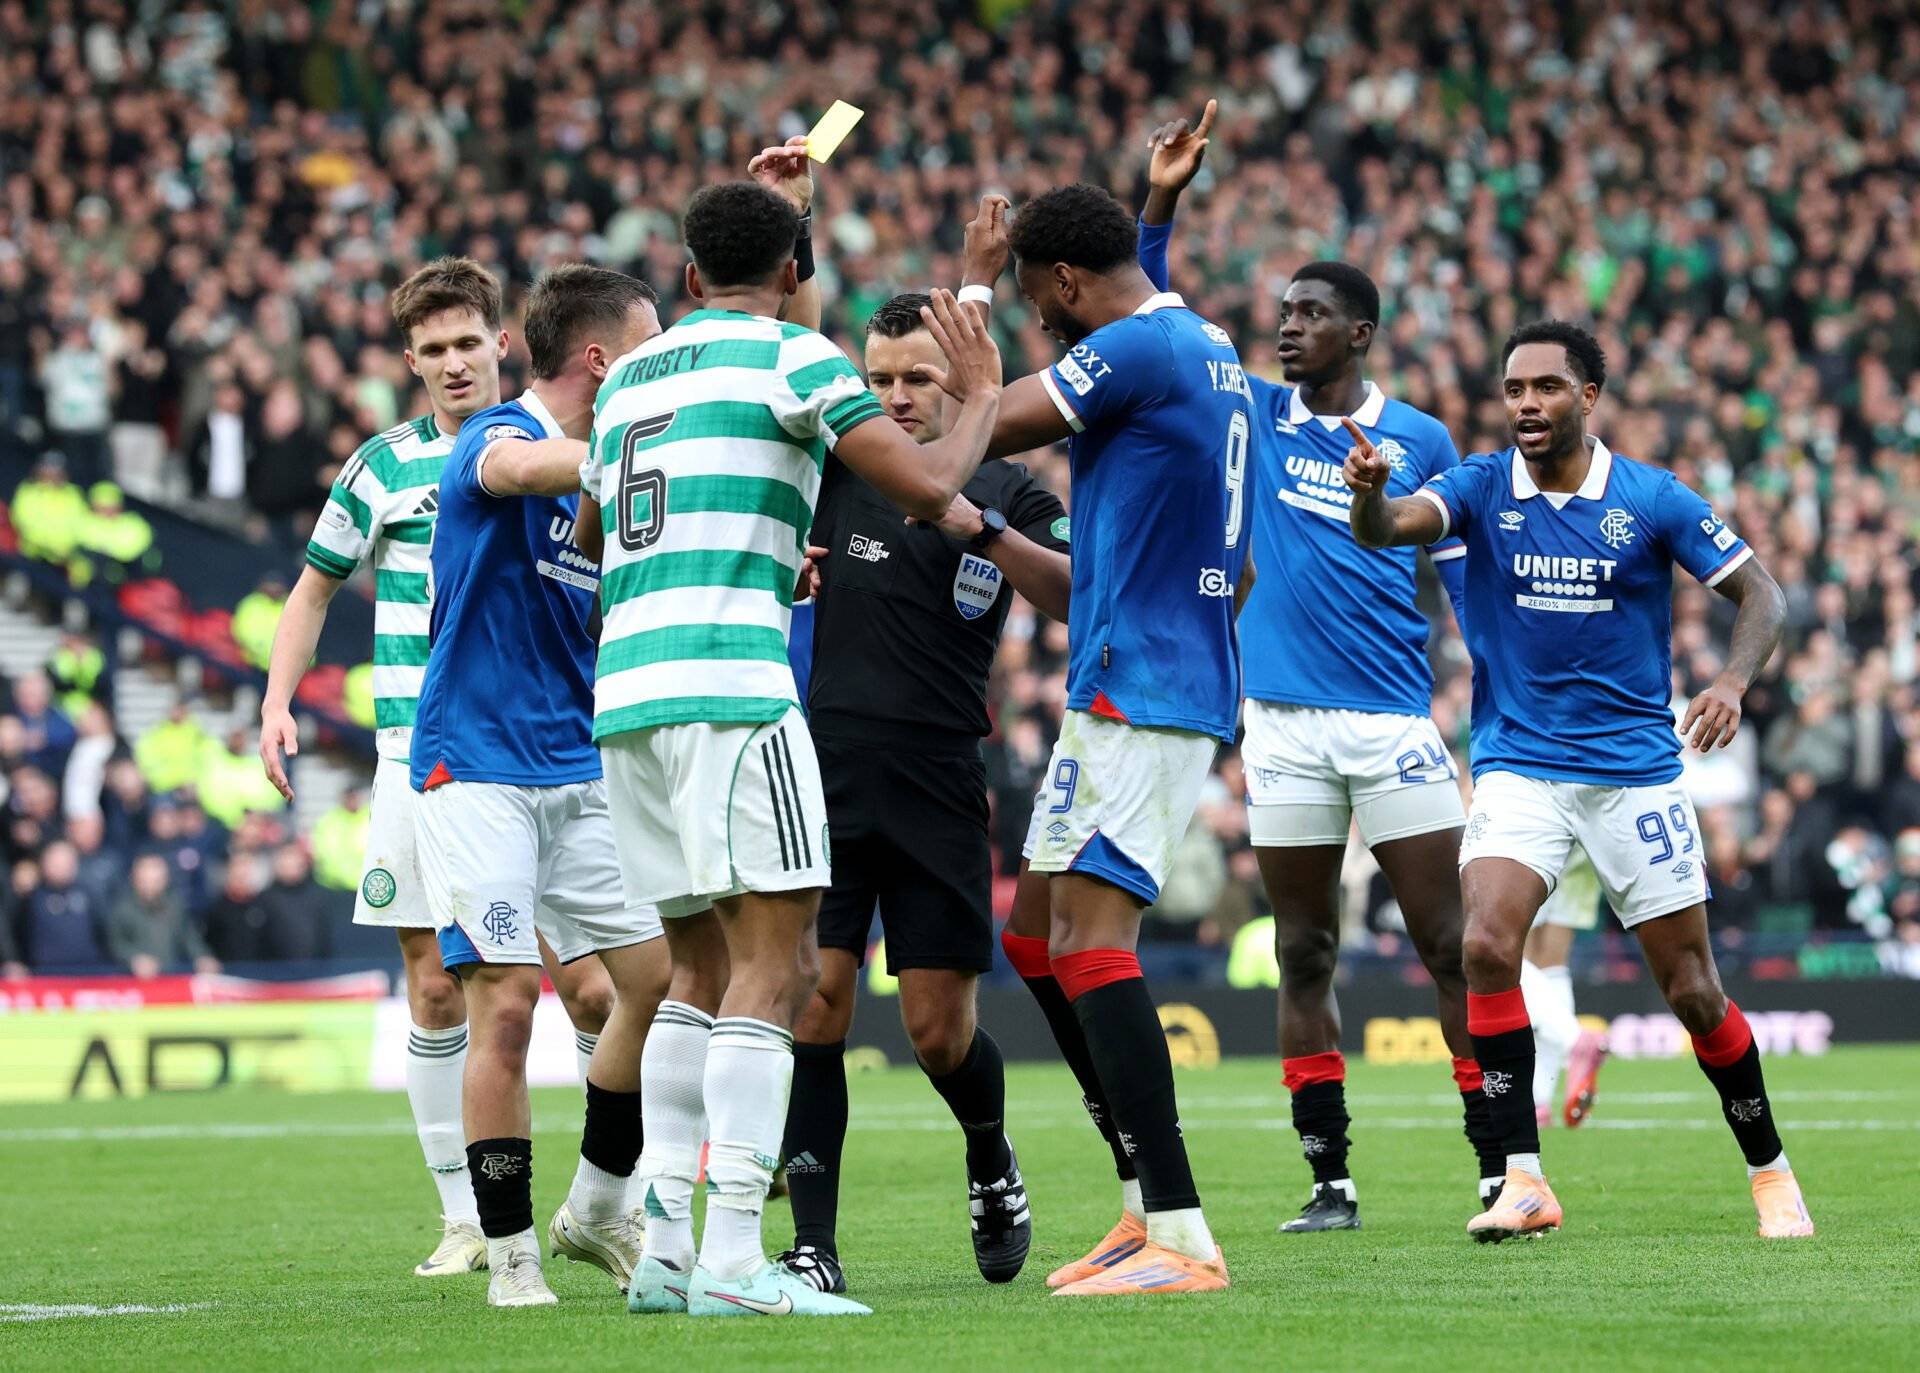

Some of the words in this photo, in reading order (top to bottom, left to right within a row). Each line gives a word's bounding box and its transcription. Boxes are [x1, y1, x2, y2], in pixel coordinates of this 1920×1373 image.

[620, 343, 708, 386] TRUSTY
[1206, 361, 1254, 405] Y.CHE
[616, 409, 677, 555] 6
[1225, 409, 1250, 549] 9
[1285, 455, 1351, 490] UNIB
[1498, 522, 1521, 531] umbro
[962, 558, 998, 583] FIFA
[1514, 553, 1617, 582] UNIBET
[957, 582, 994, 600] REFEREE
[1528, 598, 1559, 609] ZERO%
[1562, 601, 1601, 611] MISSION
[961, 604, 979, 616] 2025
[1048, 758, 1079, 814] 9
[1636, 803, 1694, 866] 99
[785, 1163, 826, 1175] adidas
